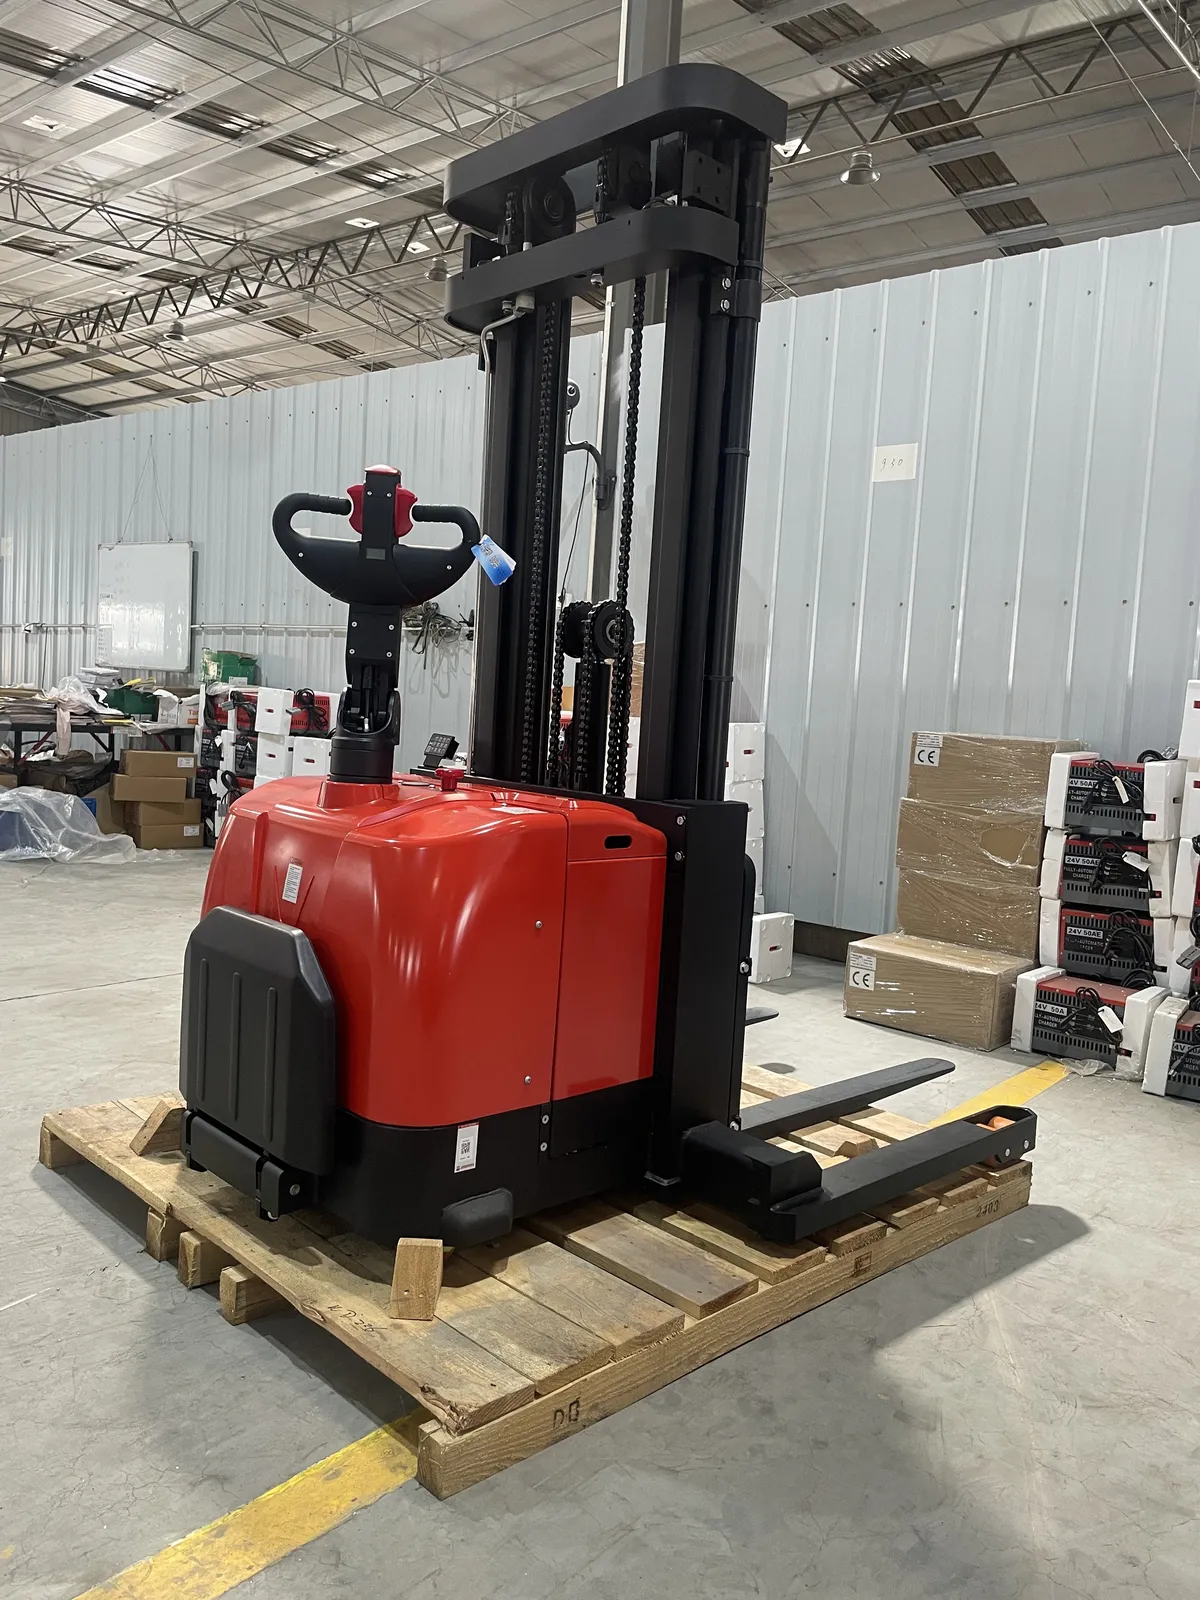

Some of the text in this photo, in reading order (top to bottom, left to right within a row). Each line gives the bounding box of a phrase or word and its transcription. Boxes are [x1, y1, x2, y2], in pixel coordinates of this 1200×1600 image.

[917, 749, 936, 765] CE
[1066, 856, 1099, 866] 24V 50AE
[1068, 927, 1102, 938] 24V 50AE
[852, 970, 871, 988] CE
[1050, 1006, 1065, 1015] 50A
[1038, 1019, 1058, 1028] CHARGER
[1173, 1043, 1186, 1052] 4V
